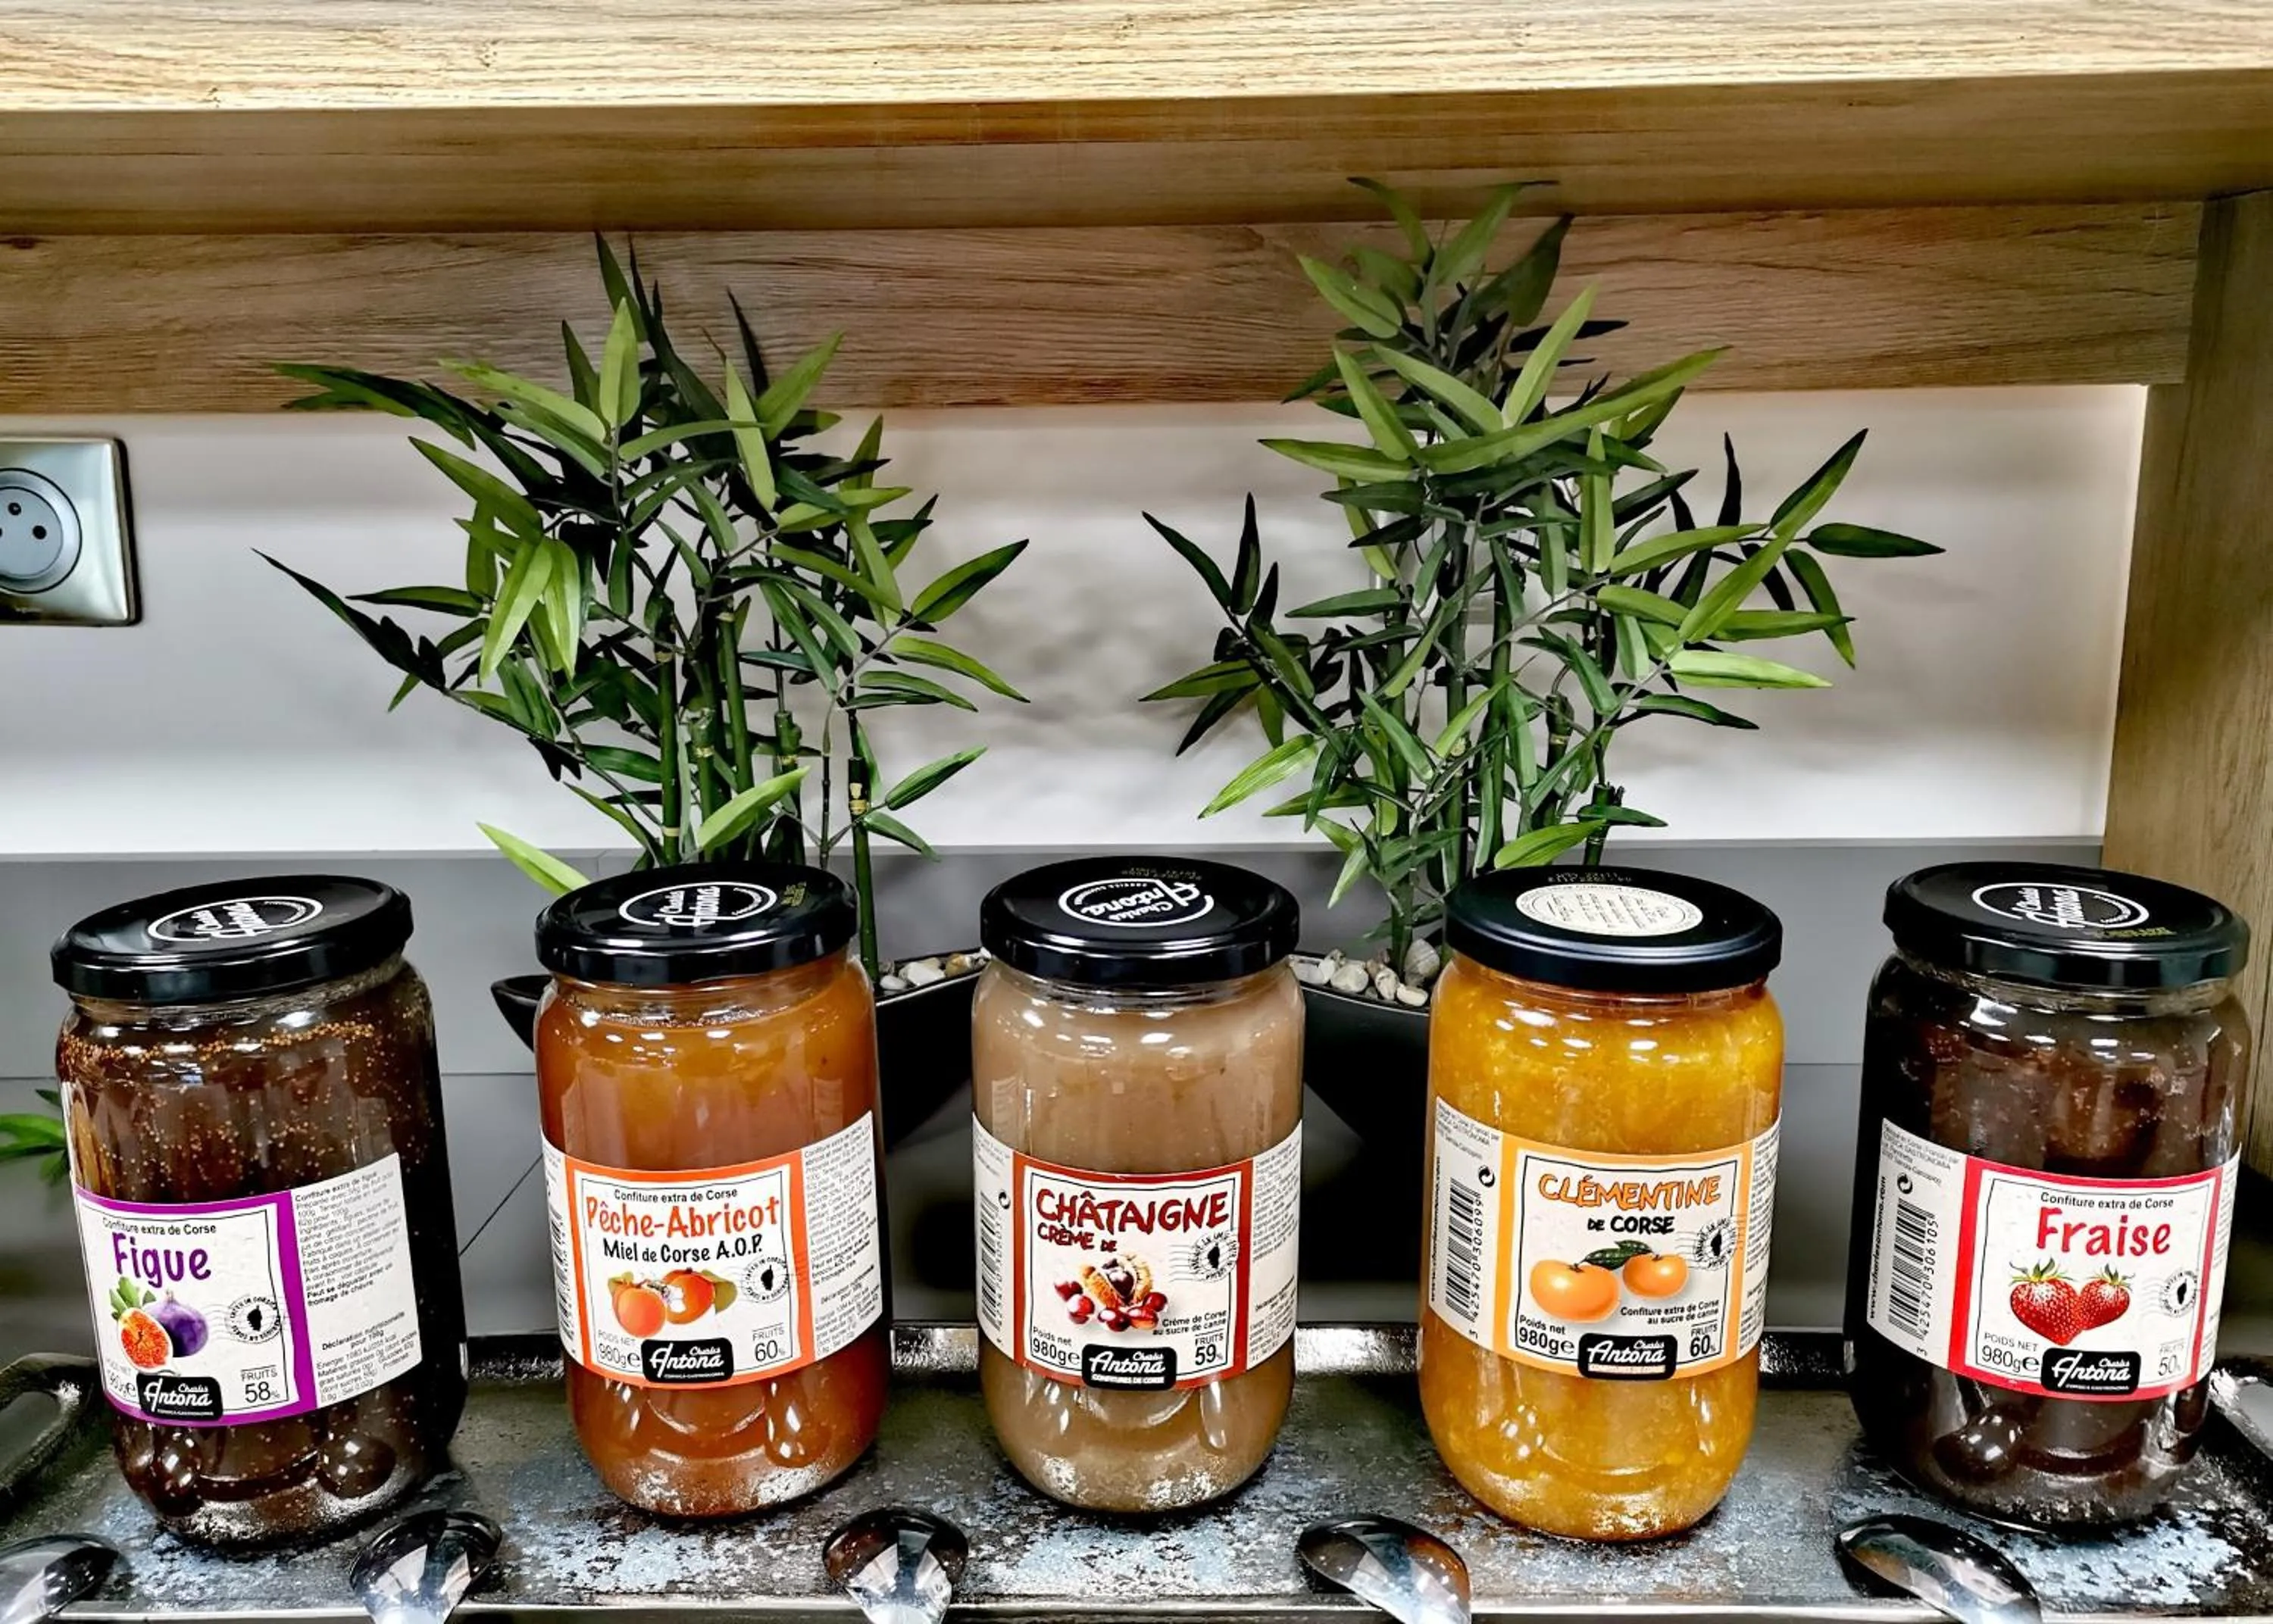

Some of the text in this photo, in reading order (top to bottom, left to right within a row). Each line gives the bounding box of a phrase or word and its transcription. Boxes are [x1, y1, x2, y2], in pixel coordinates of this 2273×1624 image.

[614, 1188, 737, 1203] Confiture extra de Corse
[1539, 1173, 1721, 1210] CLÉMENTINE
[2040, 1191, 2174, 1209] Confiture extra de Corse
[586, 1196, 780, 1238] Pêche-Abricot
[1036, 1188, 1229, 1235] CHÂTAIGNE
[141, 1224, 165, 1235] extra
[167, 1224, 181, 1235] de
[183, 1223, 217, 1235] Corse
[1610, 1215, 1675, 1235] CORSE
[2037, 1206, 2171, 1257] Fraise
[1037, 1222, 1118, 1252] CRÈME DE
[603, 1233, 762, 1263] Miel de Corse A.O.P.
[1923, 1220, 1939, 1276] 306105
[111, 1231, 212, 1288] Figue
[1193, 1315, 1202, 1325] de
[1205, 1310, 1227, 1321] Corse
[1621, 1299, 1719, 1316] Confiture extra de Corse
[1647, 1307, 1719, 1325] au sucre de canne
[1918, 1281, 1933, 1336] 425470
[752, 1328, 785, 1341] FRUITS
[1152, 1328, 1164, 1336] au
[1165, 1326, 1190, 1336] sucre
[1192, 1323, 1202, 1332] de
[1519, 1314, 1565, 1335] Poids net
[1690, 1324, 1718, 1337] FRUITS
[1033, 1326, 1072, 1346] Poids net
[1195, 1334, 1224, 1346] FRUITS
[1984, 1332, 2039, 1352] POIDS NET
[650, 1342, 724, 1378] Antona
[1090, 1351, 1165, 1373] Antona
[1587, 1341, 1665, 1363] Antona
[241, 1369, 278, 1382] FRUITS
[2052, 1353, 2131, 1387] Antona
[144, 1377, 213, 1413] Antona
